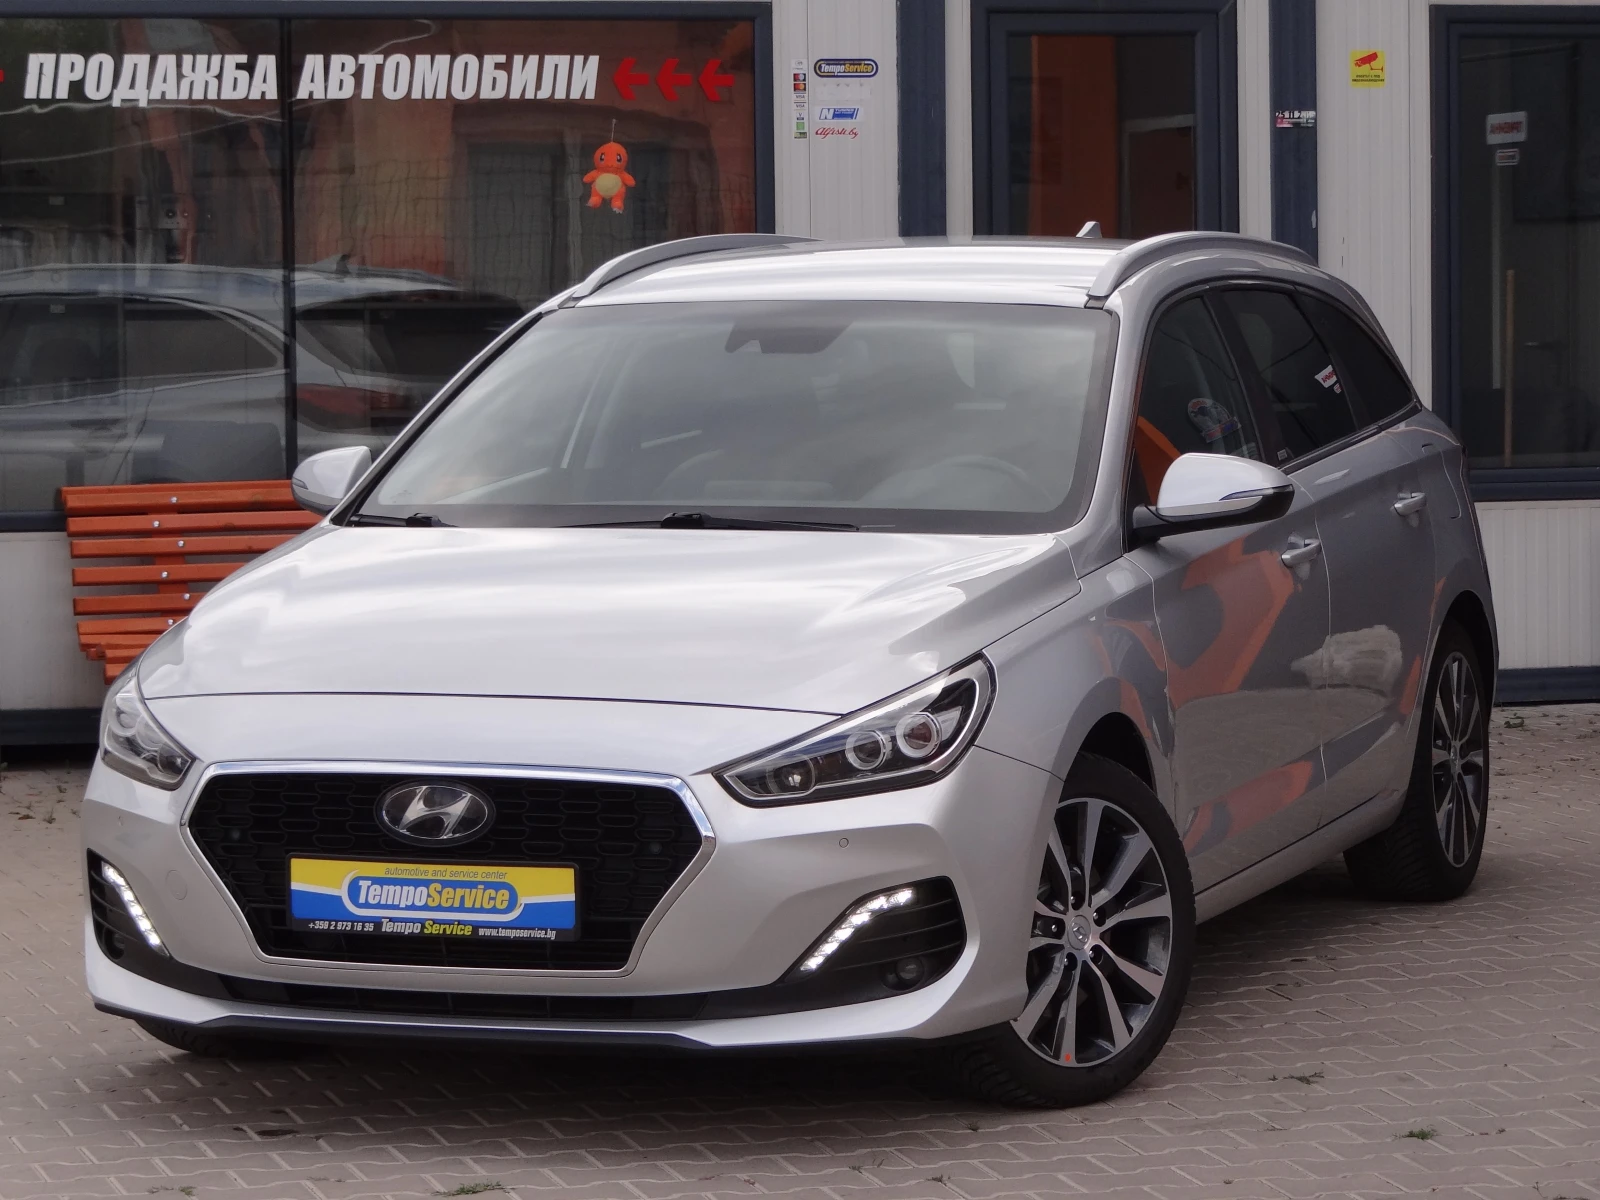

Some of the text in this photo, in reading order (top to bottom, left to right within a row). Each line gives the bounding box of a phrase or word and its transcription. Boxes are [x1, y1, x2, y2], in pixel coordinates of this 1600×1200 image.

[24, 53, 600, 107] ПРОДАЖБА АВТОМОБИЛИ
[820, 63, 873, 75] TempoService
[384, 867, 508, 879] automotive and service center
[358, 880, 510, 910] TempoService
[308, 918, 556, 940] +359 2 973 16 35 Tempo Service www.temposervice.bg
